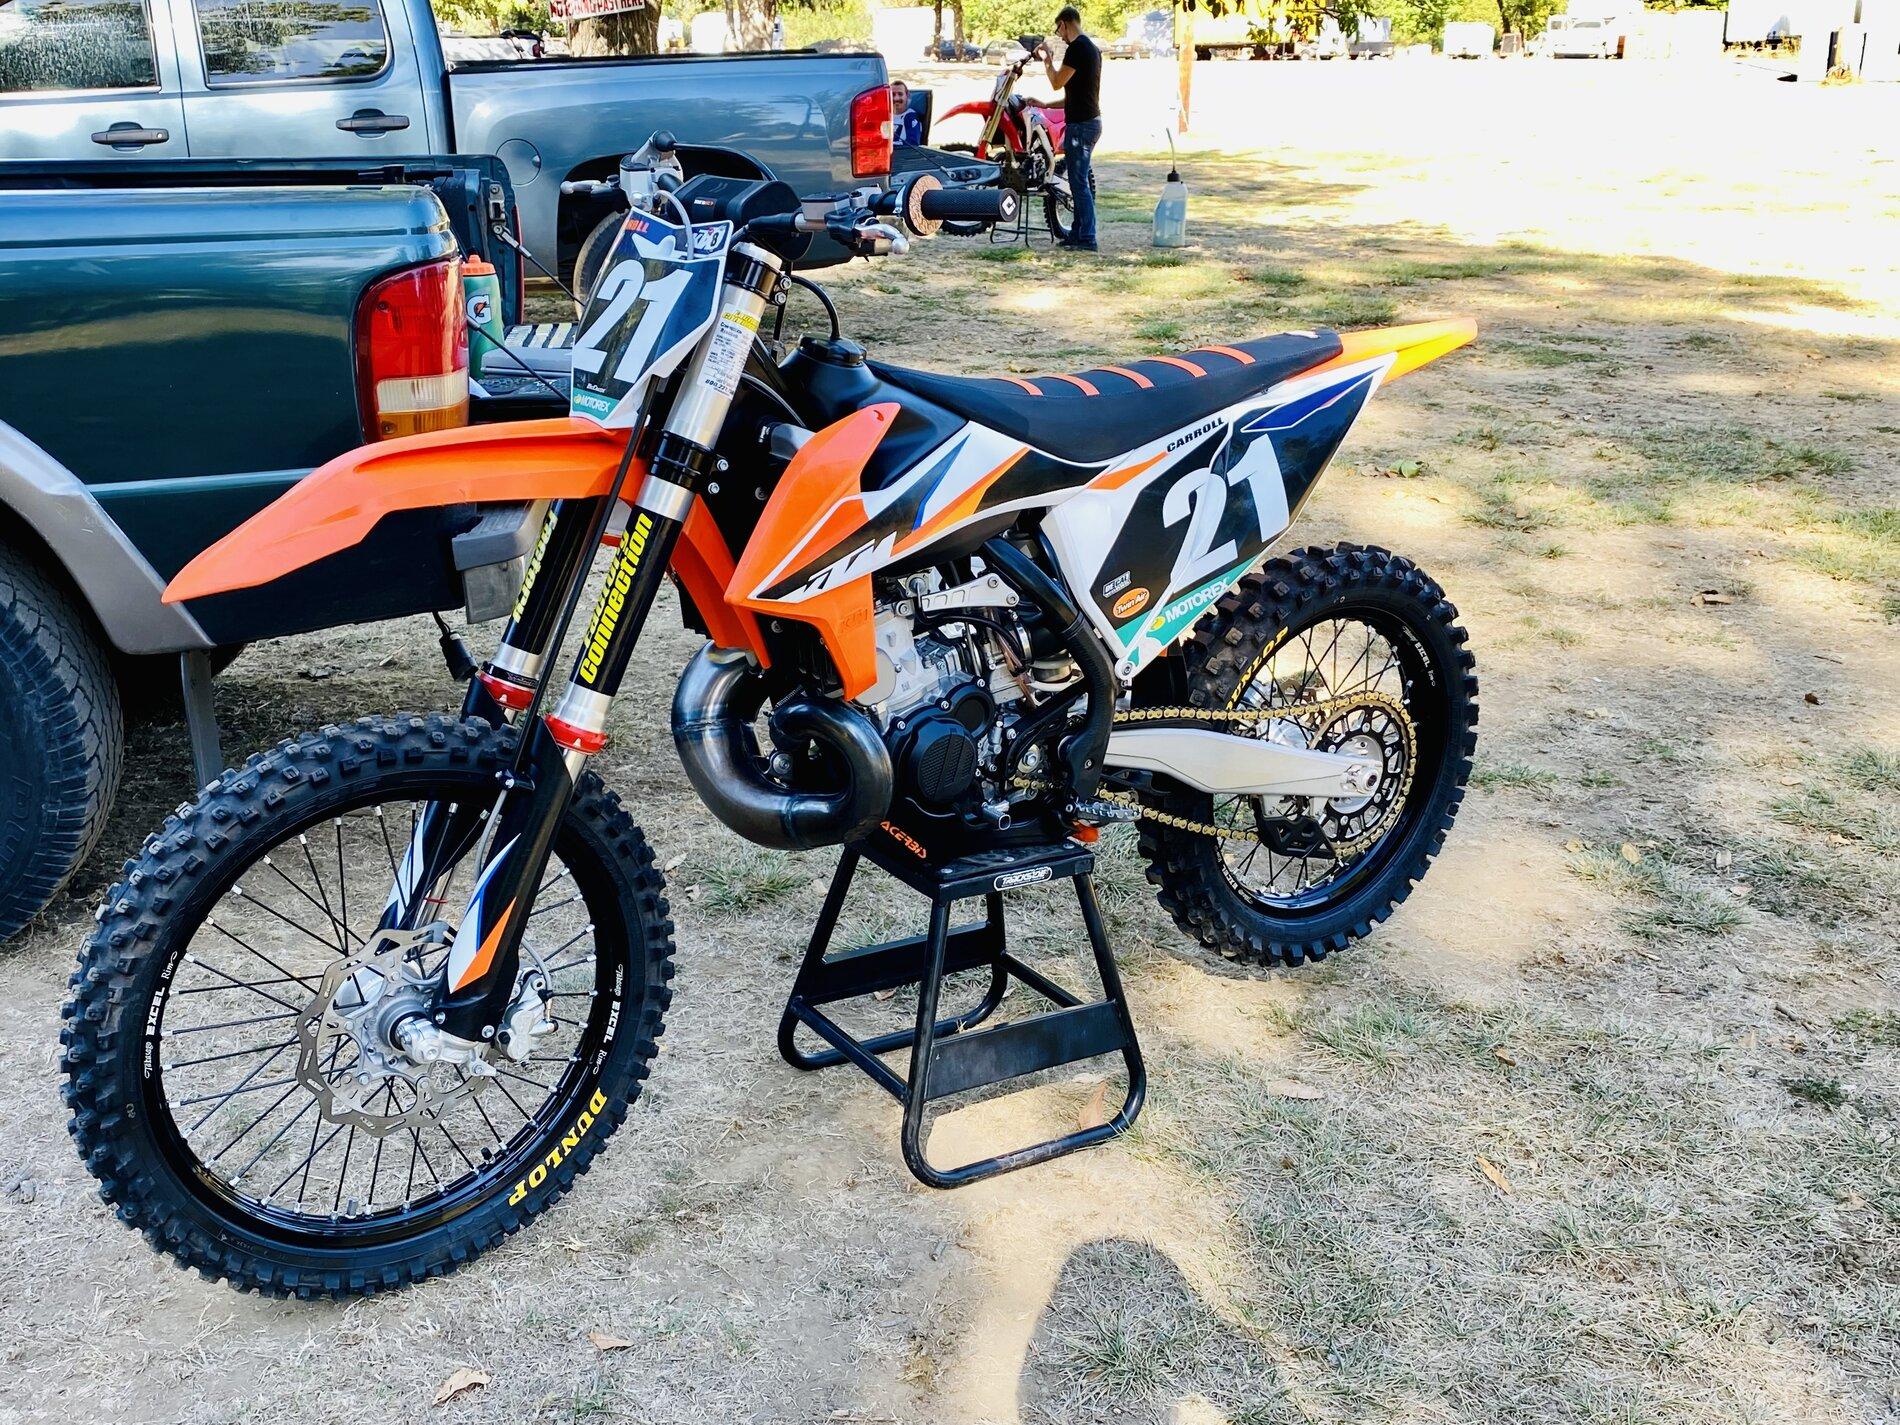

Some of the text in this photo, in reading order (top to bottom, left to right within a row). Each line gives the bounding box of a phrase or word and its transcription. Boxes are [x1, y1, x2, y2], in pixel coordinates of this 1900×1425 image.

[573, 259, 694, 384] 21
[580, 394, 611, 413] MOTOREX
[1166, 417, 1225, 453] CARROLL
[1162, 433, 1290, 594] 21
[1117, 590, 1148, 615] Twin Air
[1165, 576, 1230, 623] MOTOREX
[1415, 642, 1430, 668] EXCEL
[145, 986, 166, 1036] EXCEL
[603, 1000, 622, 1044] EXCEL
[508, 1086, 608, 1207] DUNLOP
